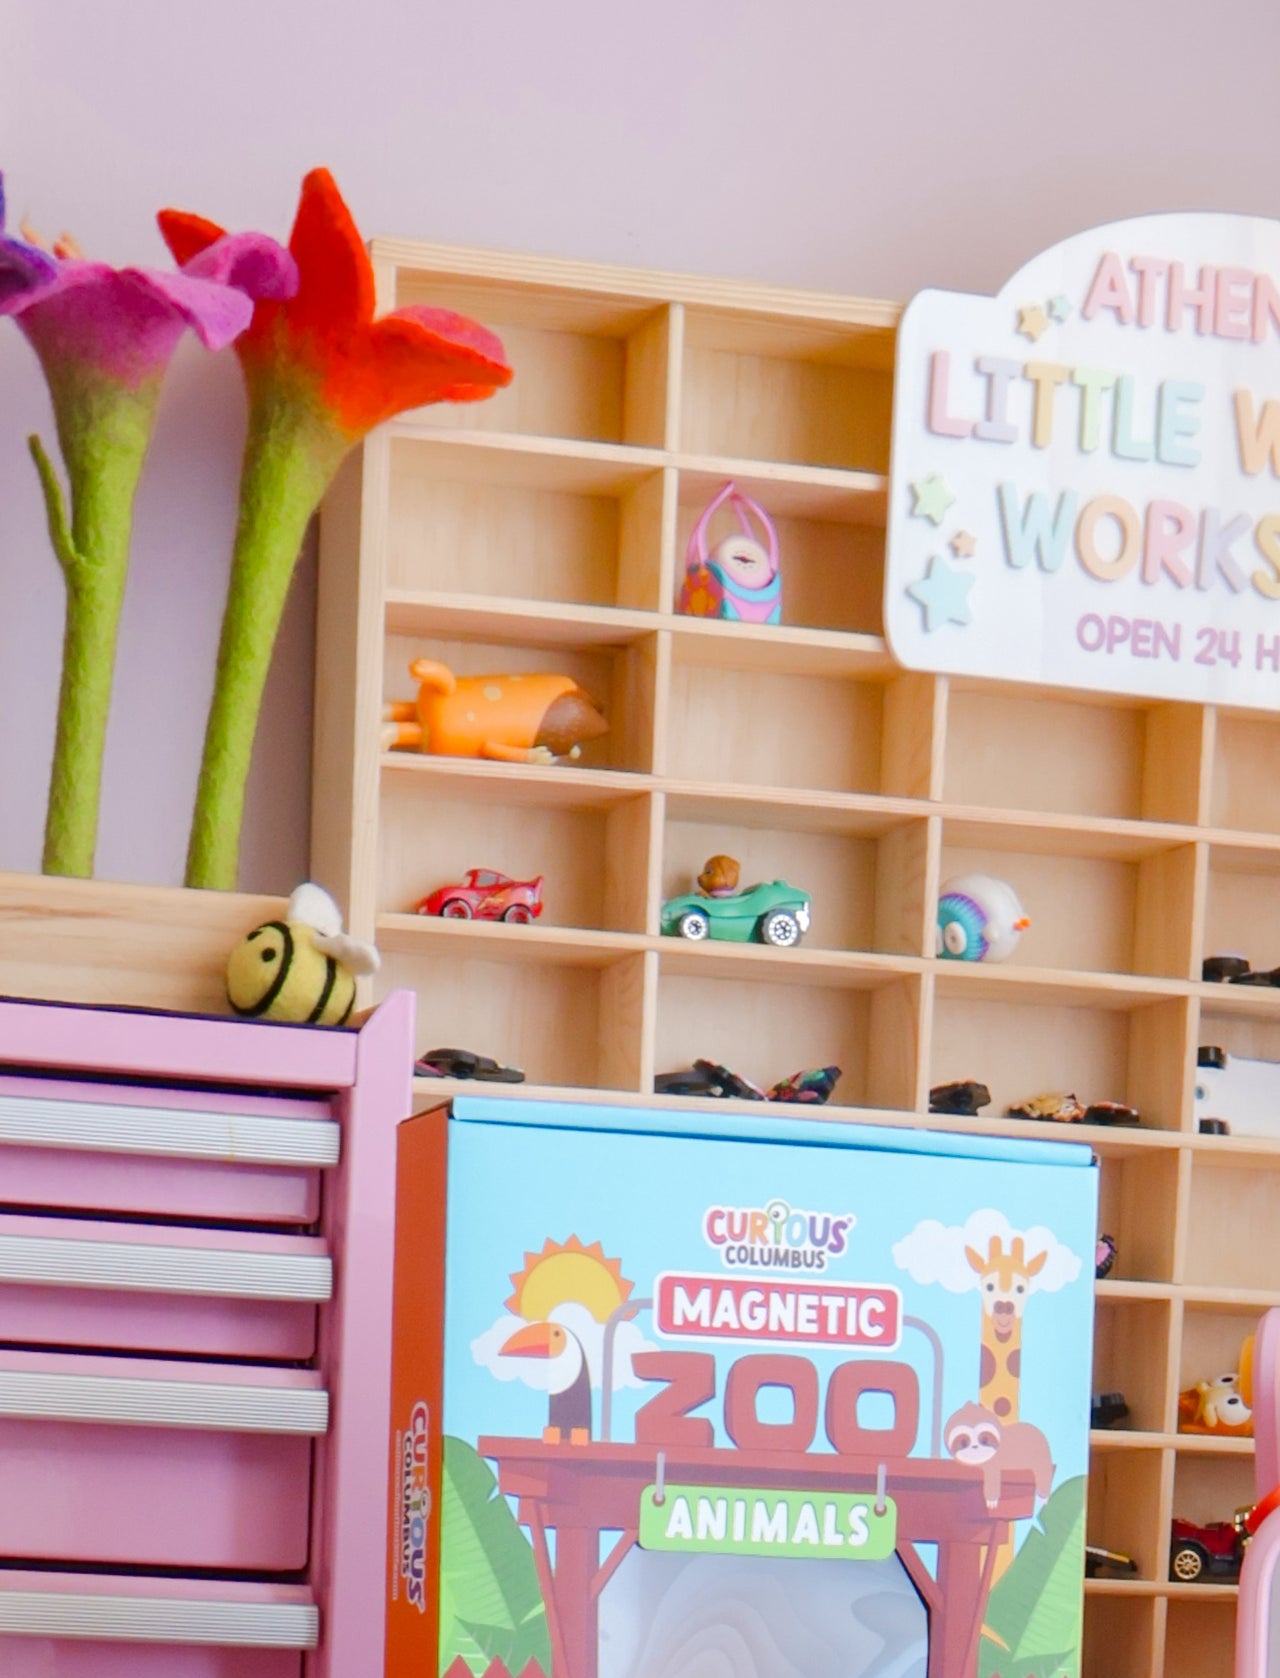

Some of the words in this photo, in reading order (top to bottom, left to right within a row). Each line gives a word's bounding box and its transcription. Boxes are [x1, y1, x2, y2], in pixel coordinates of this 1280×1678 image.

[927, 350, 1204, 467] LITTLE
[1077, 614, 1181, 660] OPEN
[1195, 629, 1241, 668] 24
[707, 1202, 848, 1253] CURIOUS
[726, 1245, 825, 1268] COLUMBUS
[672, 1286, 886, 1338] MAGNETIC
[632, 1351, 919, 1456] ZOO
[408, 1406, 430, 1603] CURIOUS
[666, 1493, 869, 1546] ANIMALS
